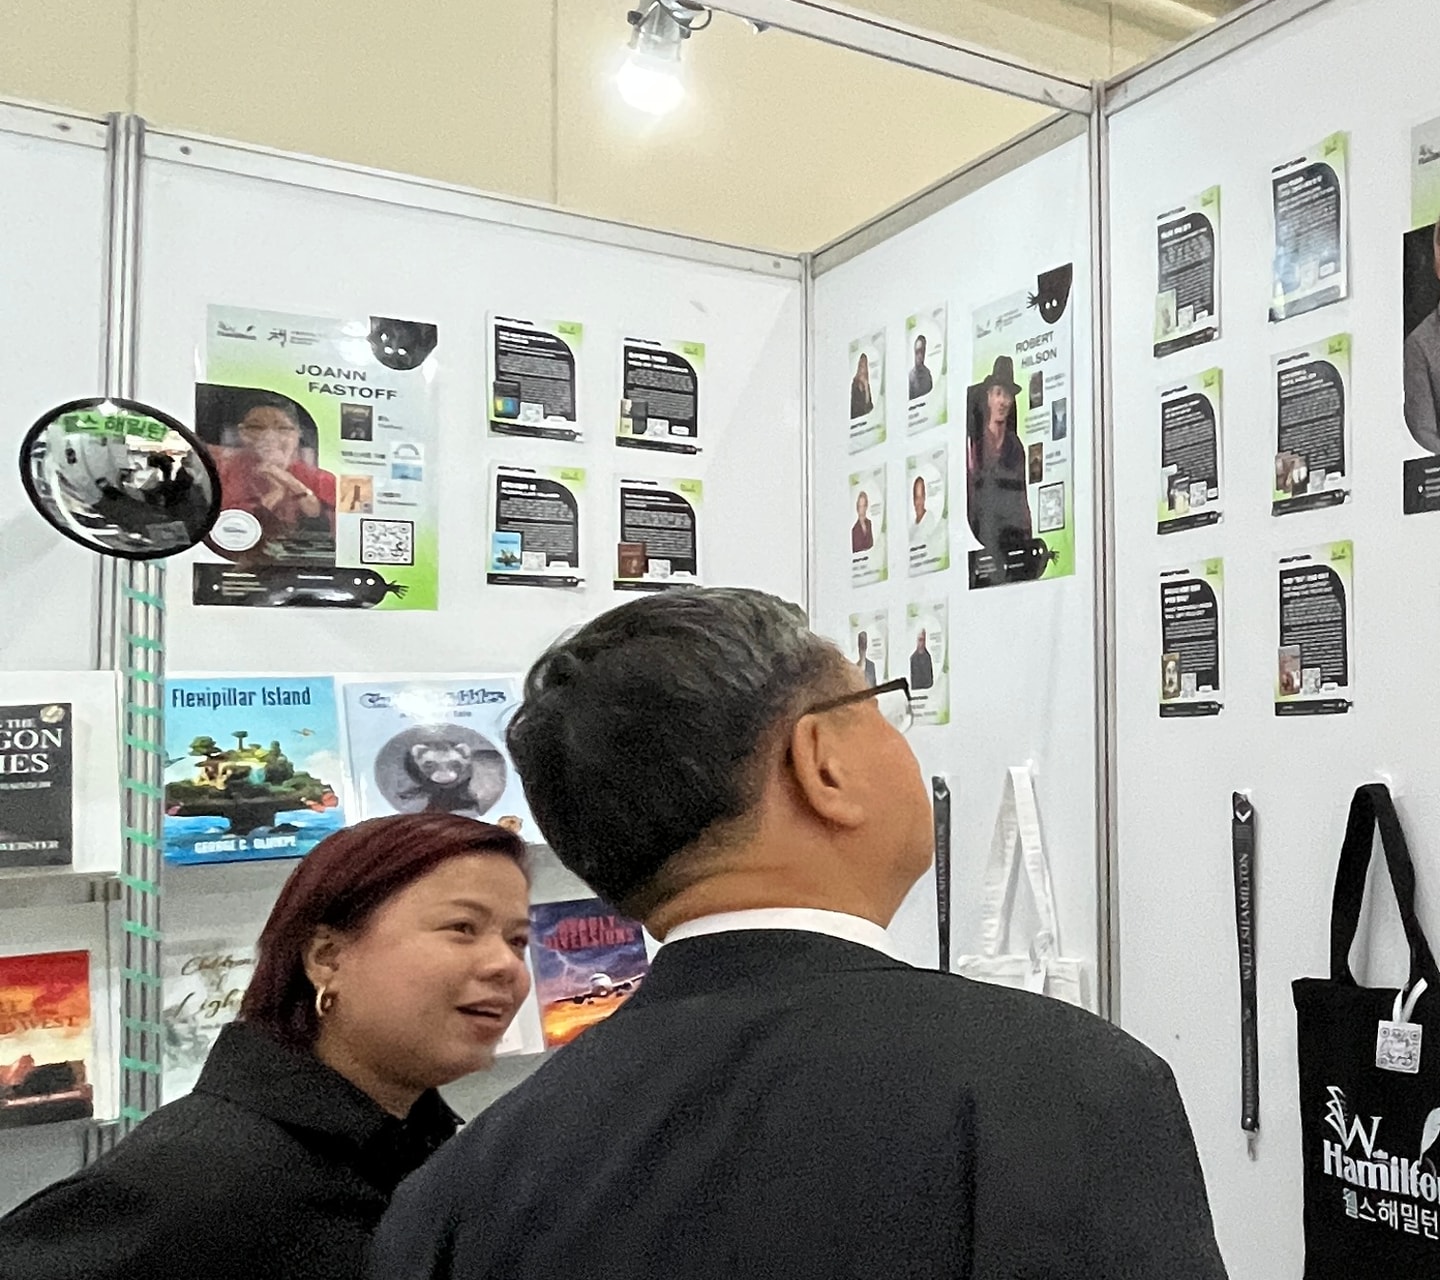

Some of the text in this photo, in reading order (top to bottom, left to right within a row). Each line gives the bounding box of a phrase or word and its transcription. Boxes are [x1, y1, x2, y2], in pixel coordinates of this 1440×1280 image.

[295, 363, 368, 382] JOANN
[308, 382, 398, 401] FASTOFF
[262, 686, 311, 706] Island
[1342, 1187, 1439, 1240] 웰스해밀턴
